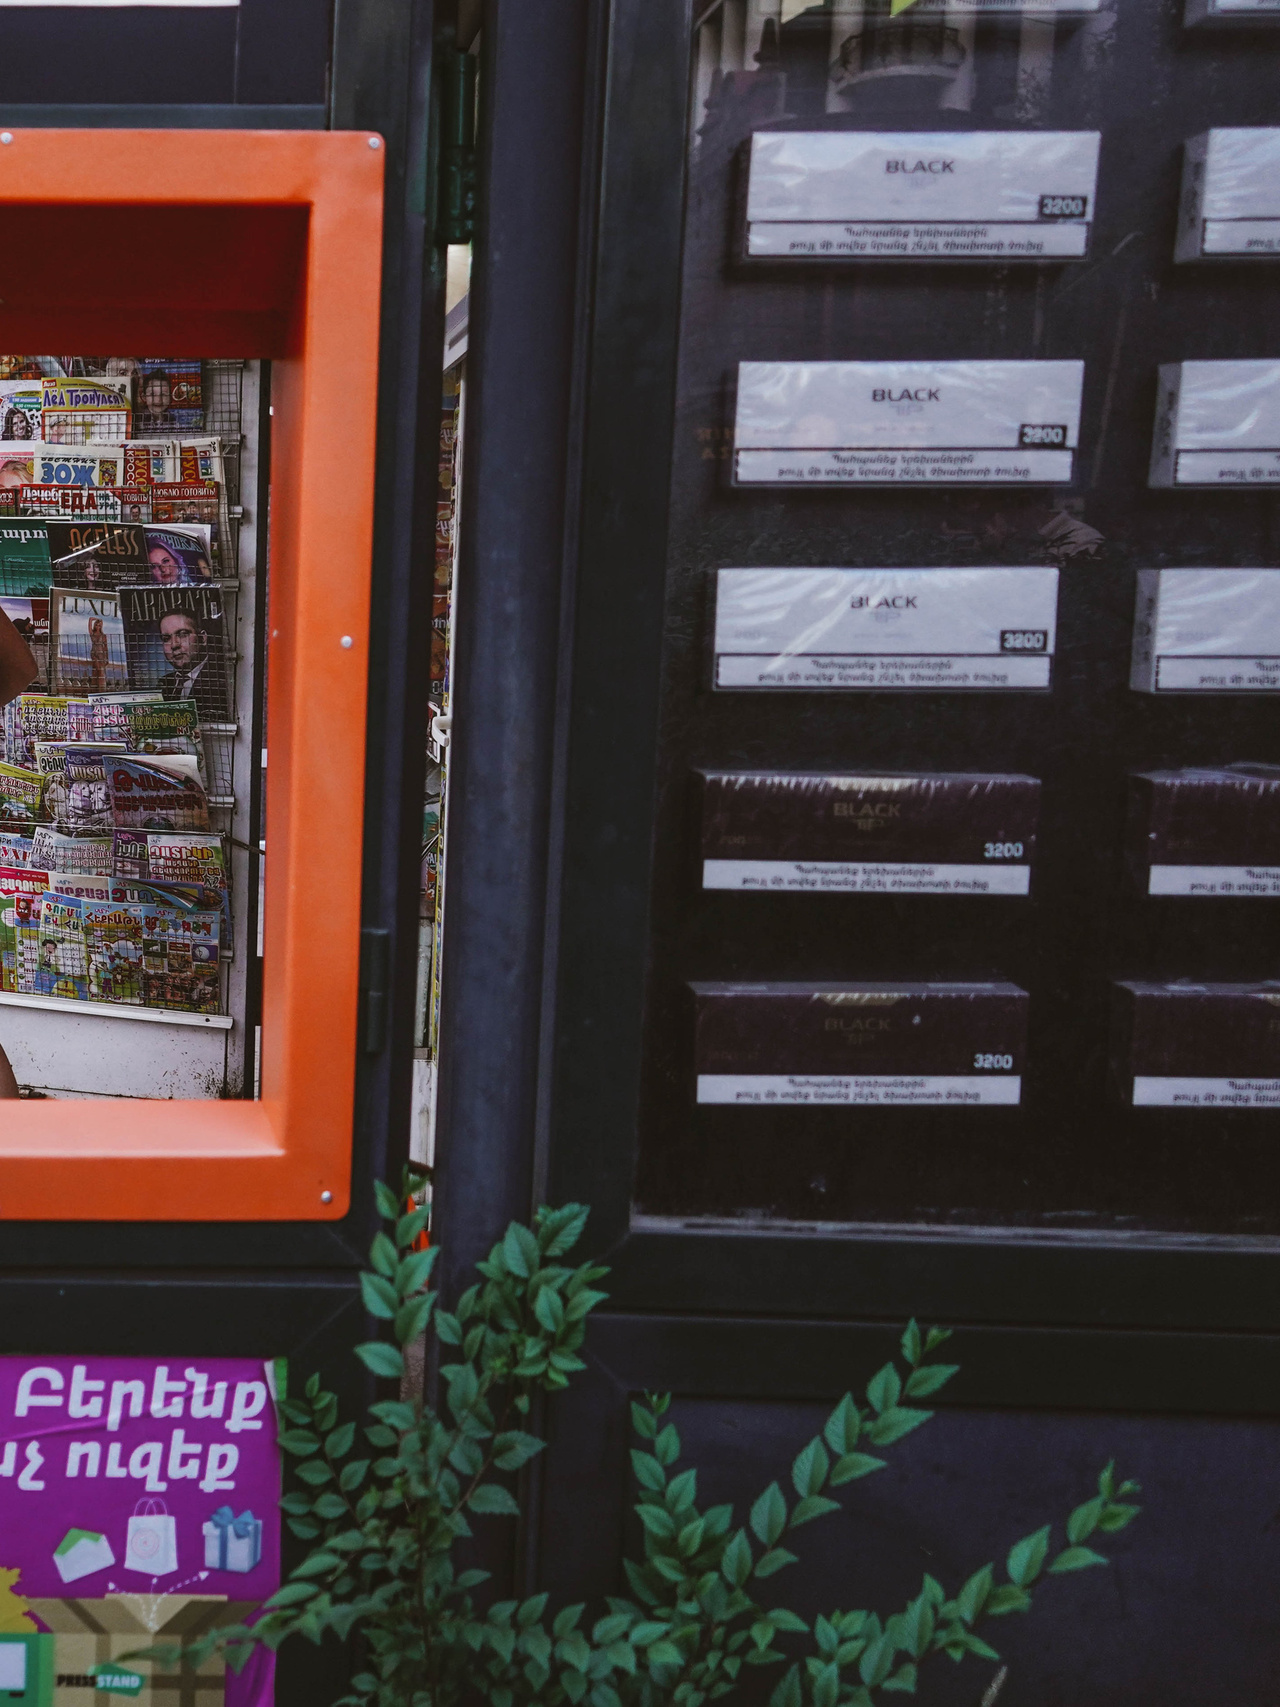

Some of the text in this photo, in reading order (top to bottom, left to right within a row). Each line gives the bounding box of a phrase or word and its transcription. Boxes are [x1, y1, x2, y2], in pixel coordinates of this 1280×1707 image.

[885, 160, 955, 174] BLACK
[1042, 197, 1083, 215] 3200
[43, 389, 65, 408] Лёд
[872, 388, 940, 402] BLACK
[1022, 426, 1063, 443] 3200
[40, 462, 96, 486] ЗОЖ
[60, 492, 98, 512] ЕДА
[850, 595, 918, 610] BLACK
[1003, 632, 1044, 649] 3200
[833, 802, 900, 817] BLACK
[983, 842, 1023, 858] 3200
[973, 1052, 1013, 1070] 3200
[15, 1365, 267, 1434] Բերենք
[65, 1428, 240, 1493] ուզեք
